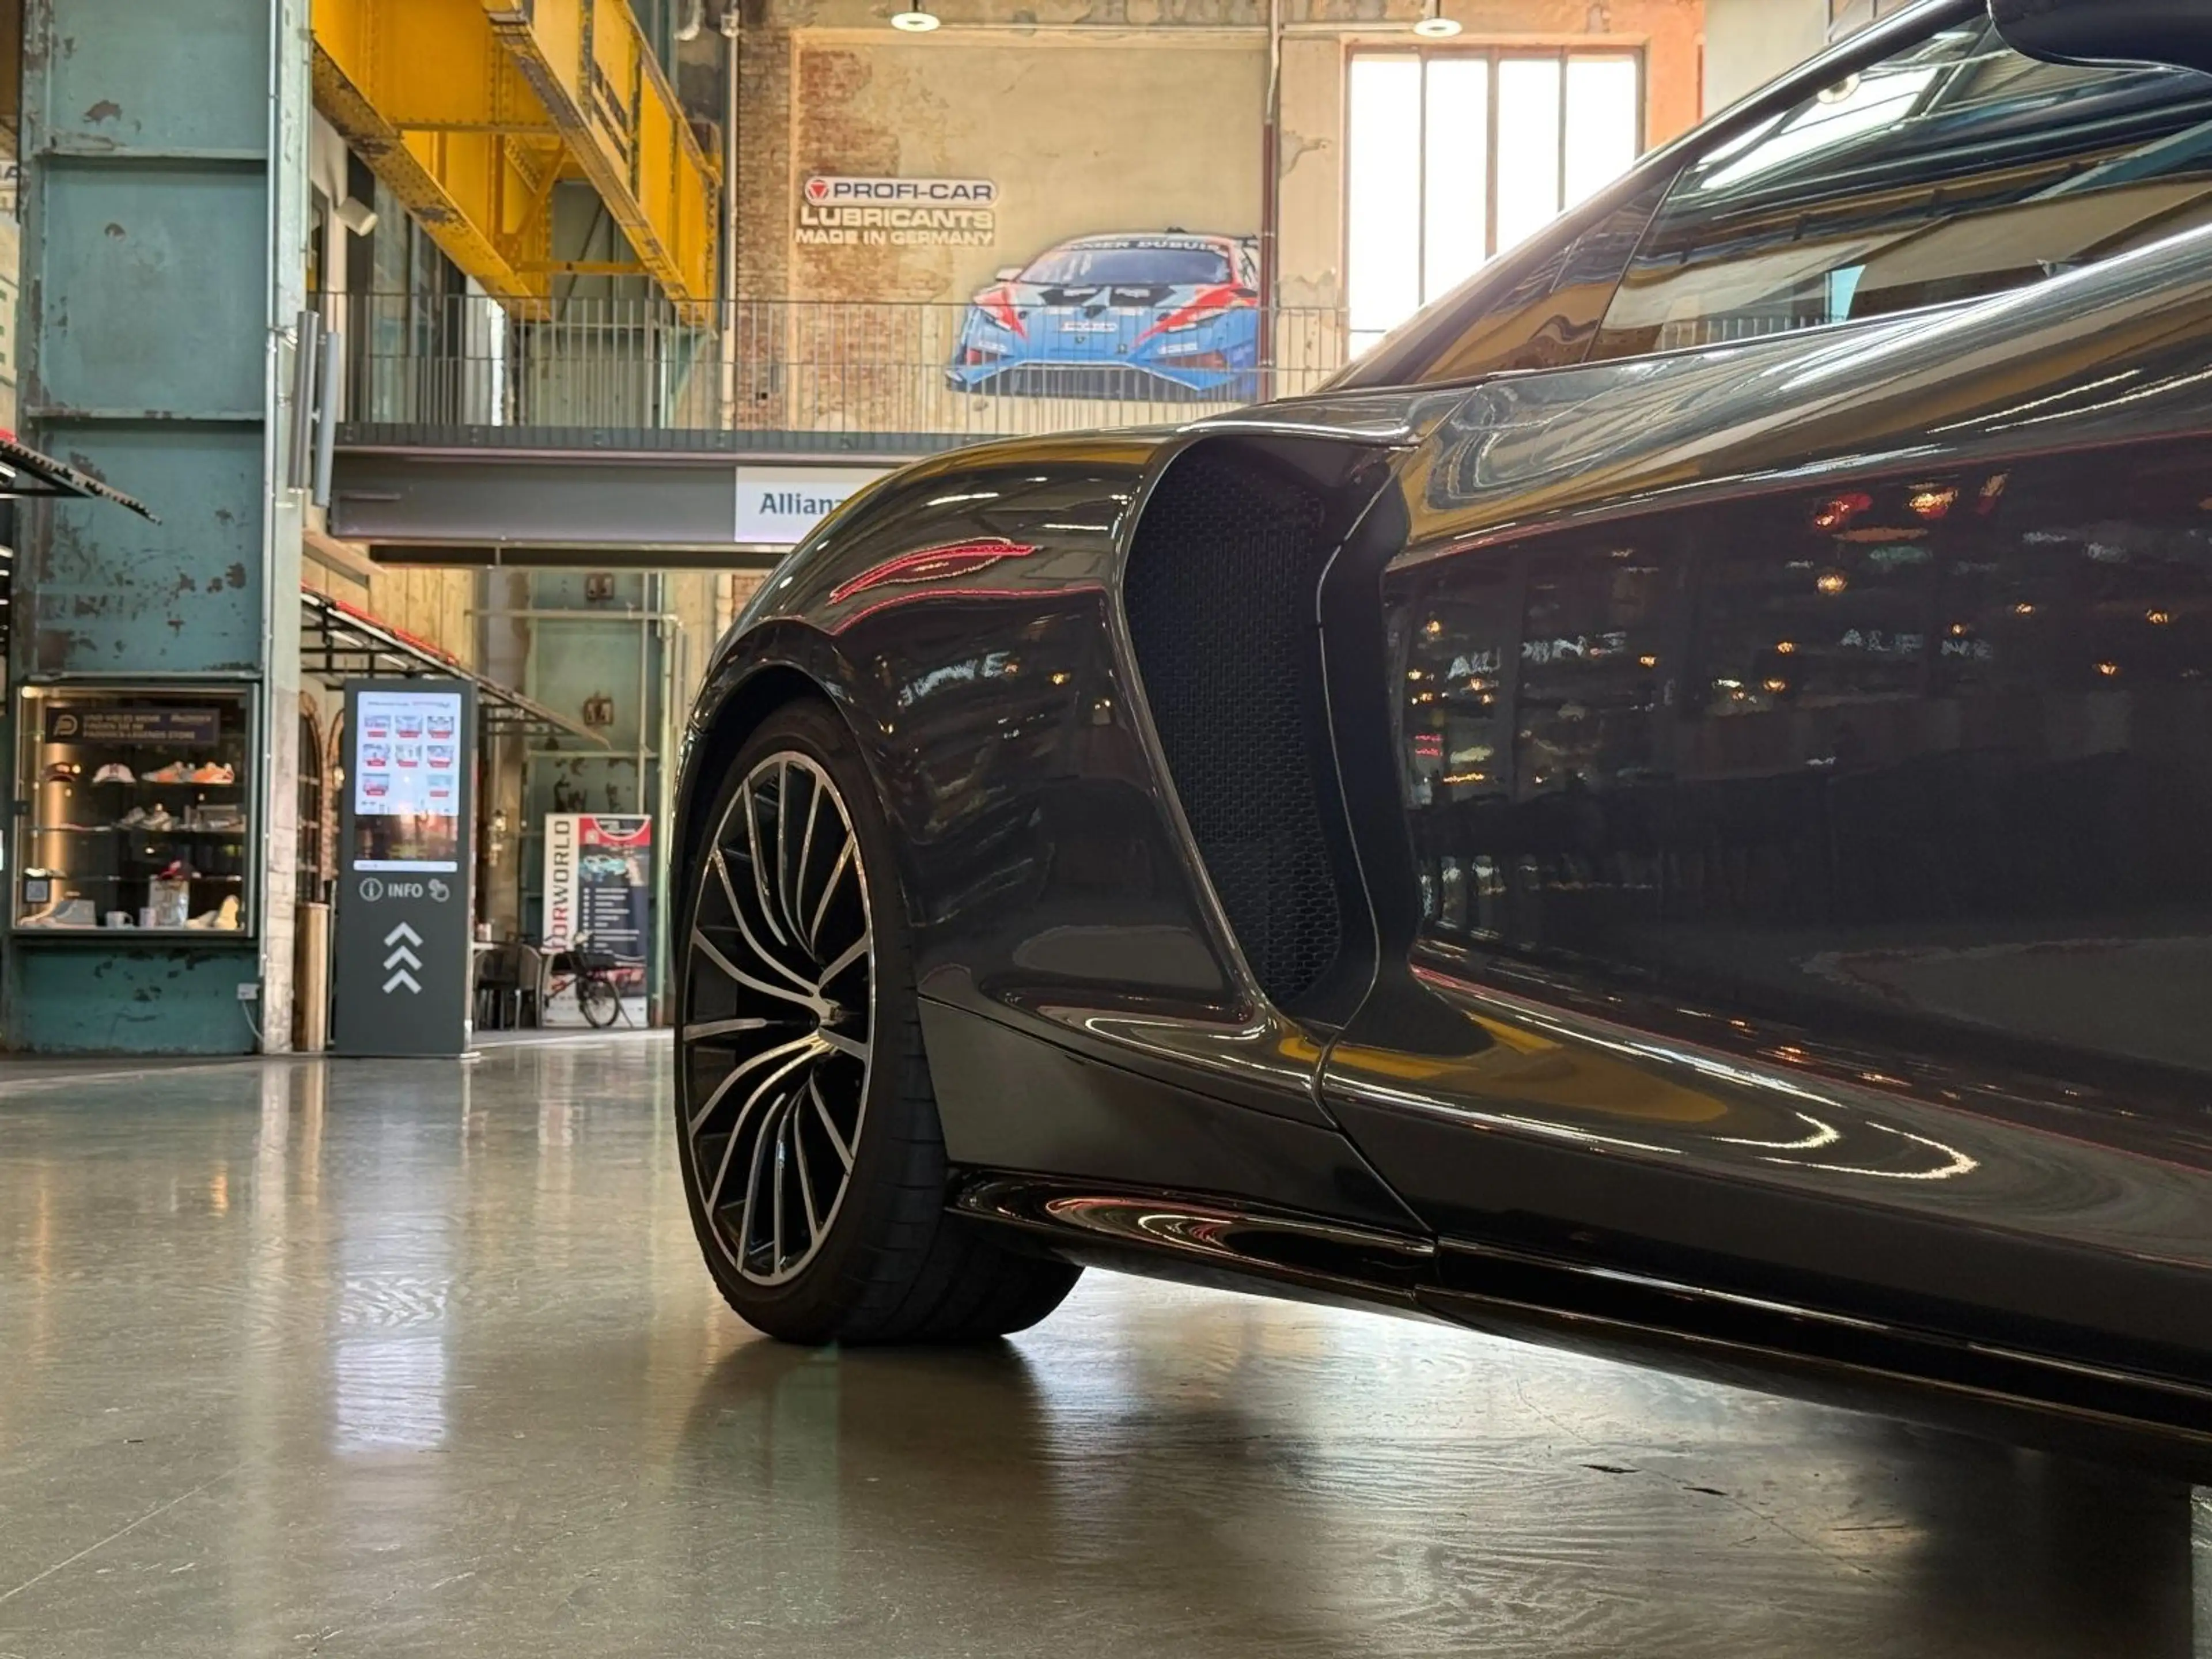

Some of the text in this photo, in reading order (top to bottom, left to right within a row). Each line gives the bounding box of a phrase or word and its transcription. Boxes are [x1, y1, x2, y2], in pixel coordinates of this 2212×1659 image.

[834, 182, 992, 200] PROFI-CAR
[800, 206, 994, 229] LUBRICANTS
[795, 228, 994, 247] MADE IN GERMANY
[551, 820, 571, 936] ORWORLD
[388, 883, 423, 898] INFO
